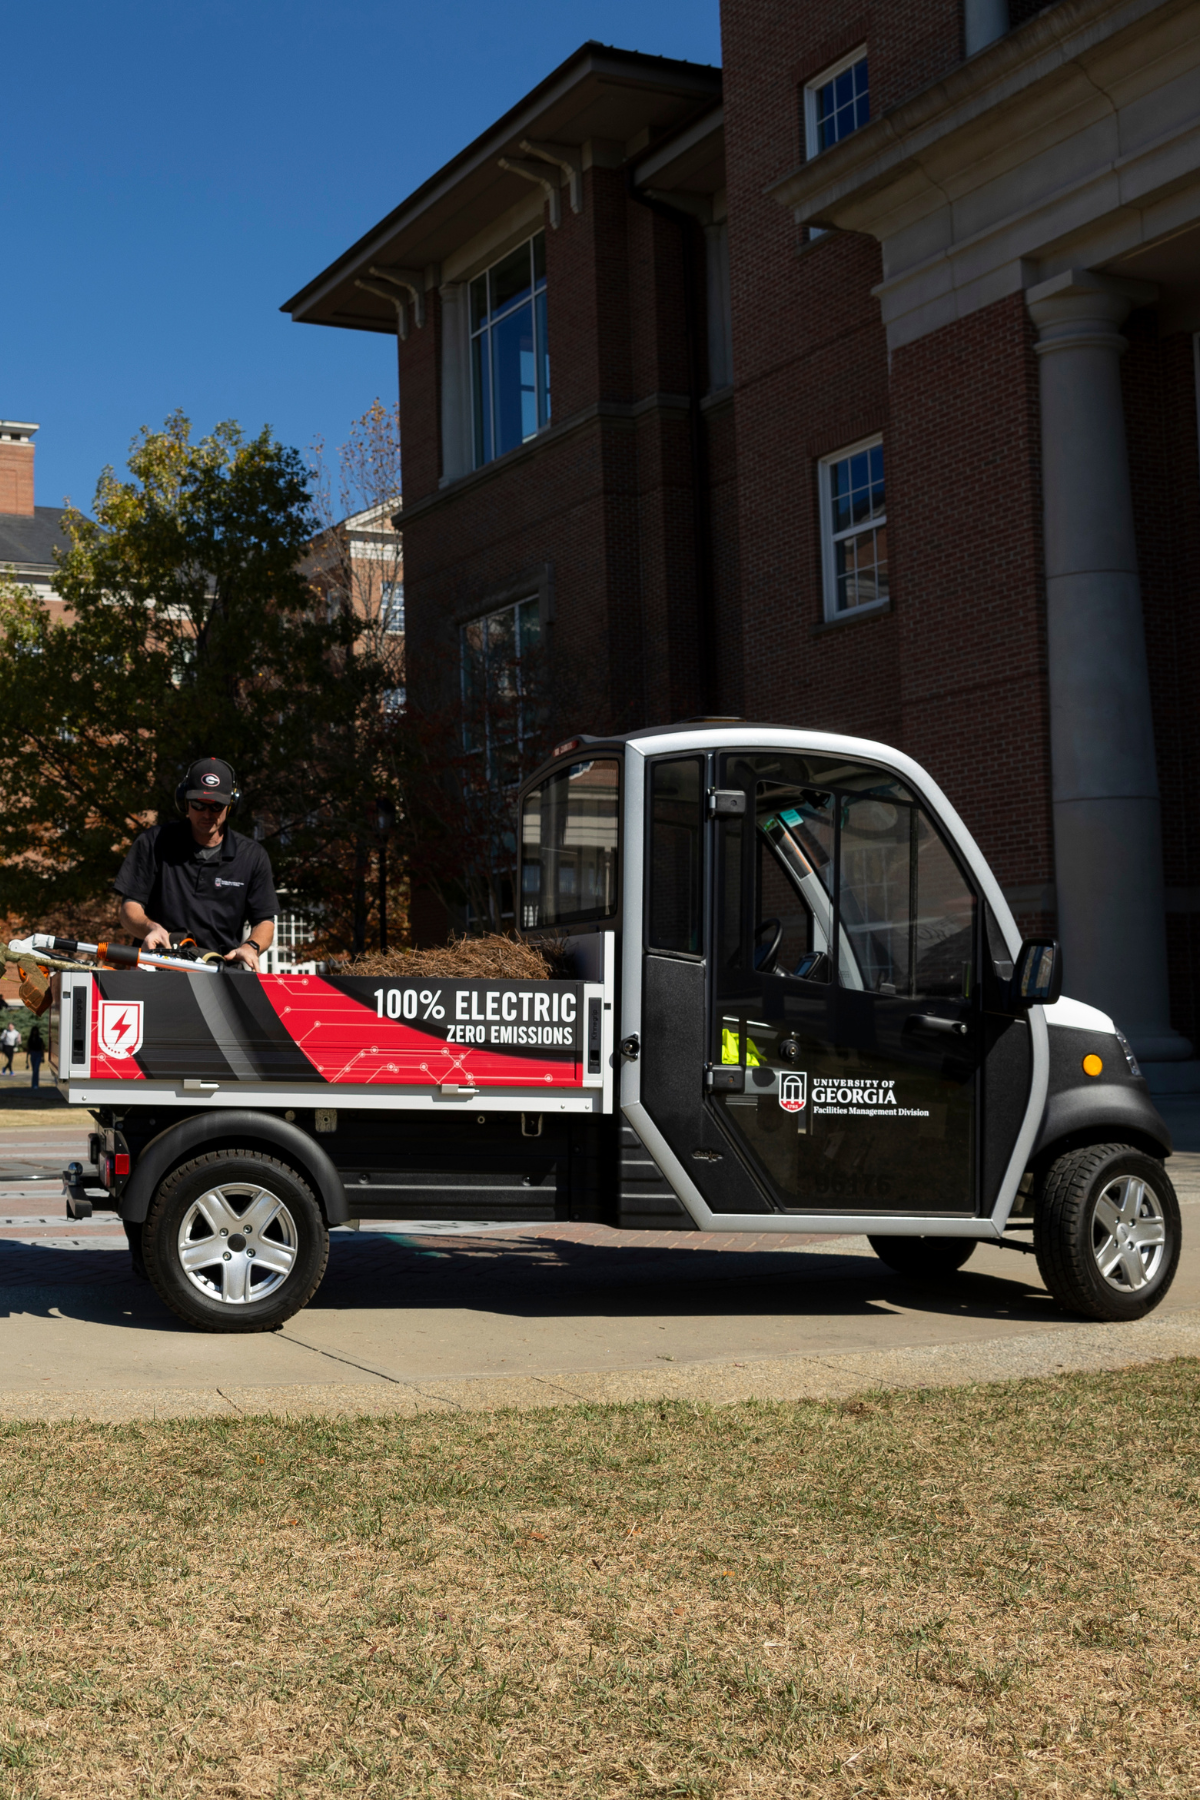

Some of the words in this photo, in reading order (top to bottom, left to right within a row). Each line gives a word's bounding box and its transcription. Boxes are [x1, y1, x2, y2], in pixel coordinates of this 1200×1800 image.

[373, 988, 446, 1020] 100%
[455, 990, 577, 1023] ELECTRIC
[591, 1009, 599, 1040] Kinnegrip
[446, 1024, 486, 1043] ZERO
[490, 1025, 573, 1045] EMISSIONS
[813, 1078, 879, 1088] UNIVERSITY
[881, 1080, 895, 1088] OF
[811, 1087, 897, 1104] GEORGIA
[813, 1106, 848, 1115] Facilities
[848, 1107, 897, 1116] Management
[898, 1108, 930, 1117] Division
